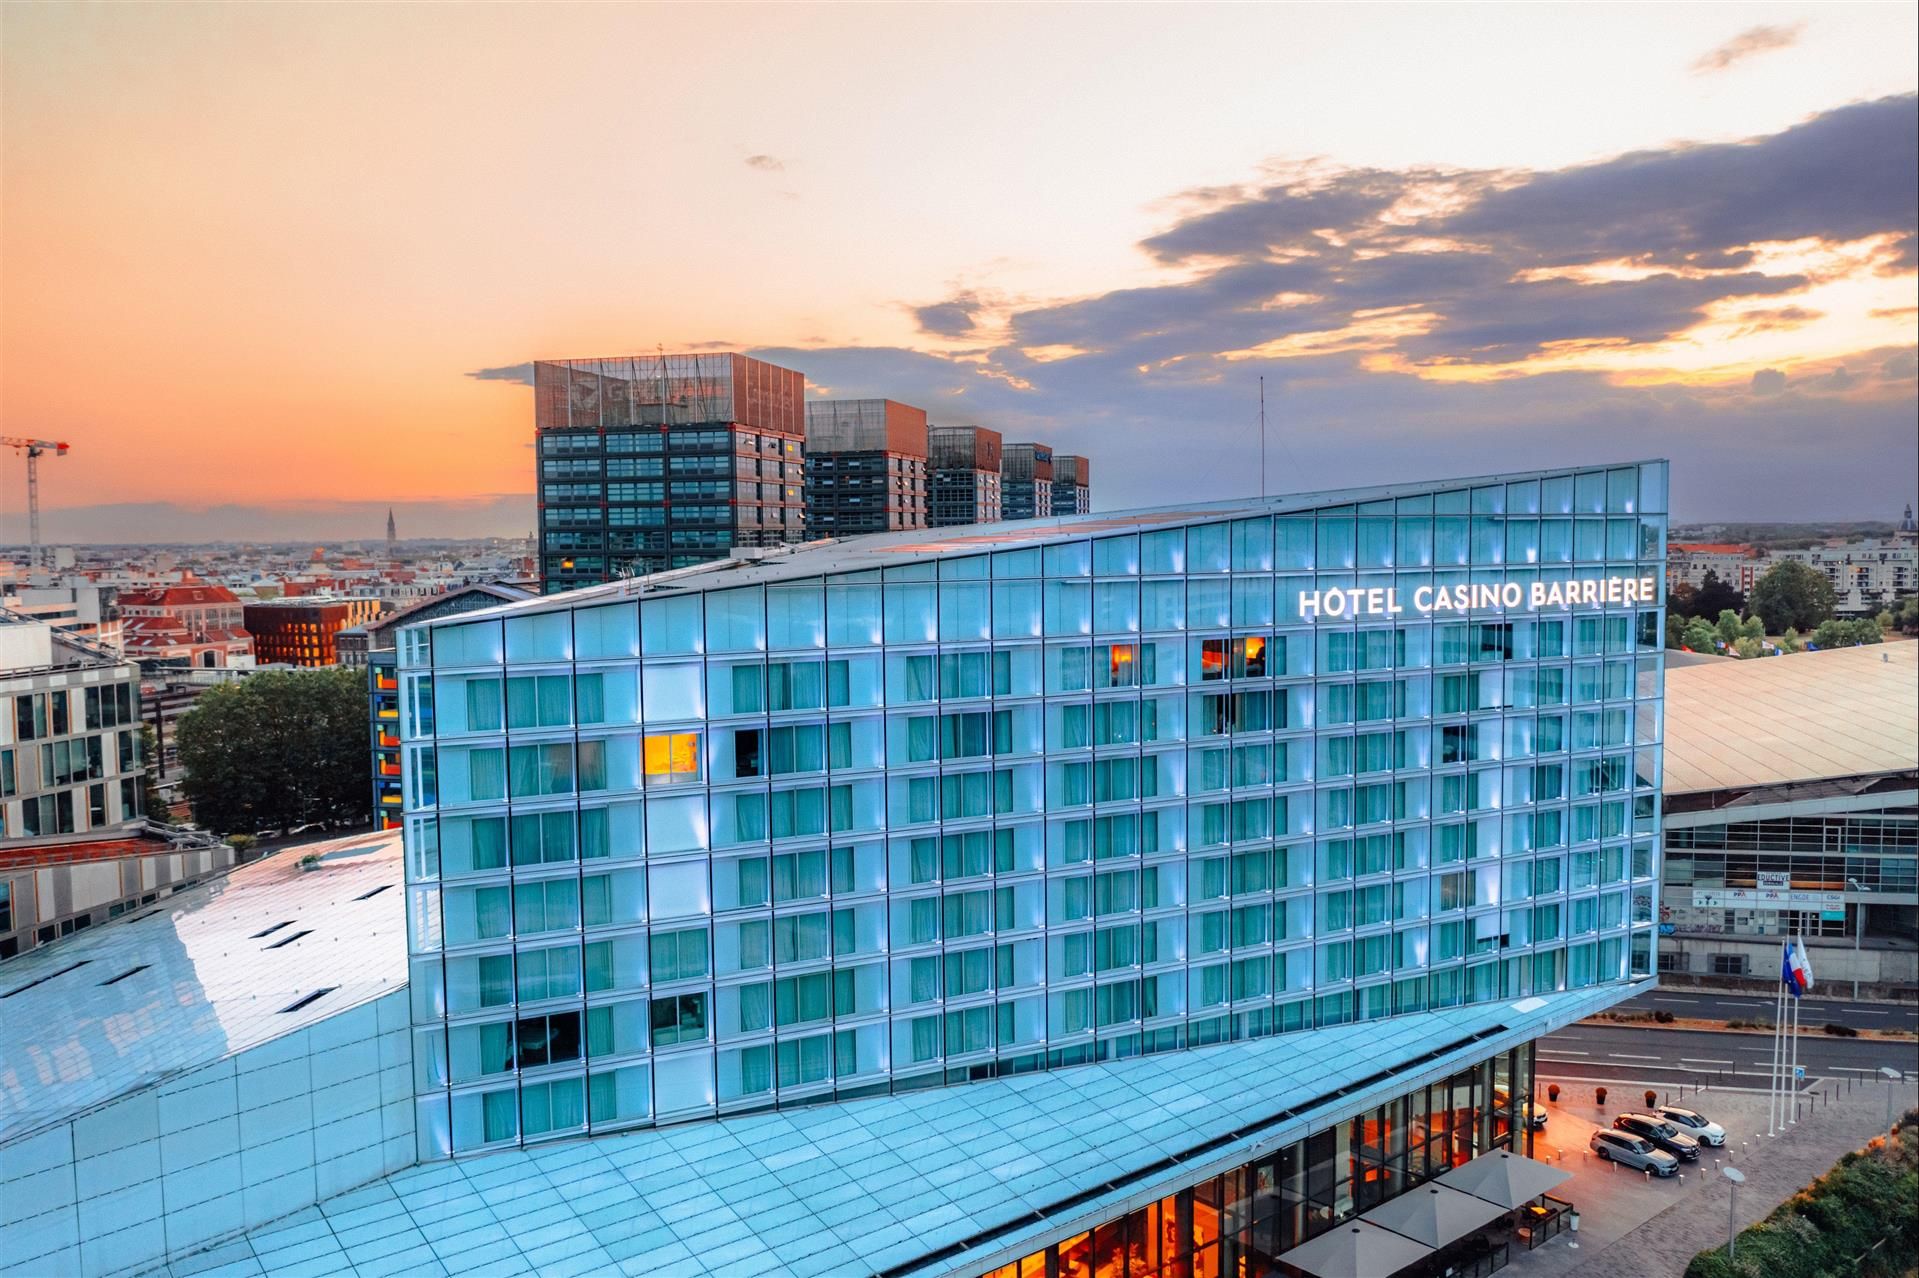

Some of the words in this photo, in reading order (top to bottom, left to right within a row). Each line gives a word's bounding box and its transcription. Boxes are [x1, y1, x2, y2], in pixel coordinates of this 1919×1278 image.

[1298, 586, 1402, 617] HÔTEL
[1413, 582, 1522, 613] CASINO
[1529, 576, 1654, 607] BARRIÈRE
[1757, 873, 1790, 881] EDUCTIVE
